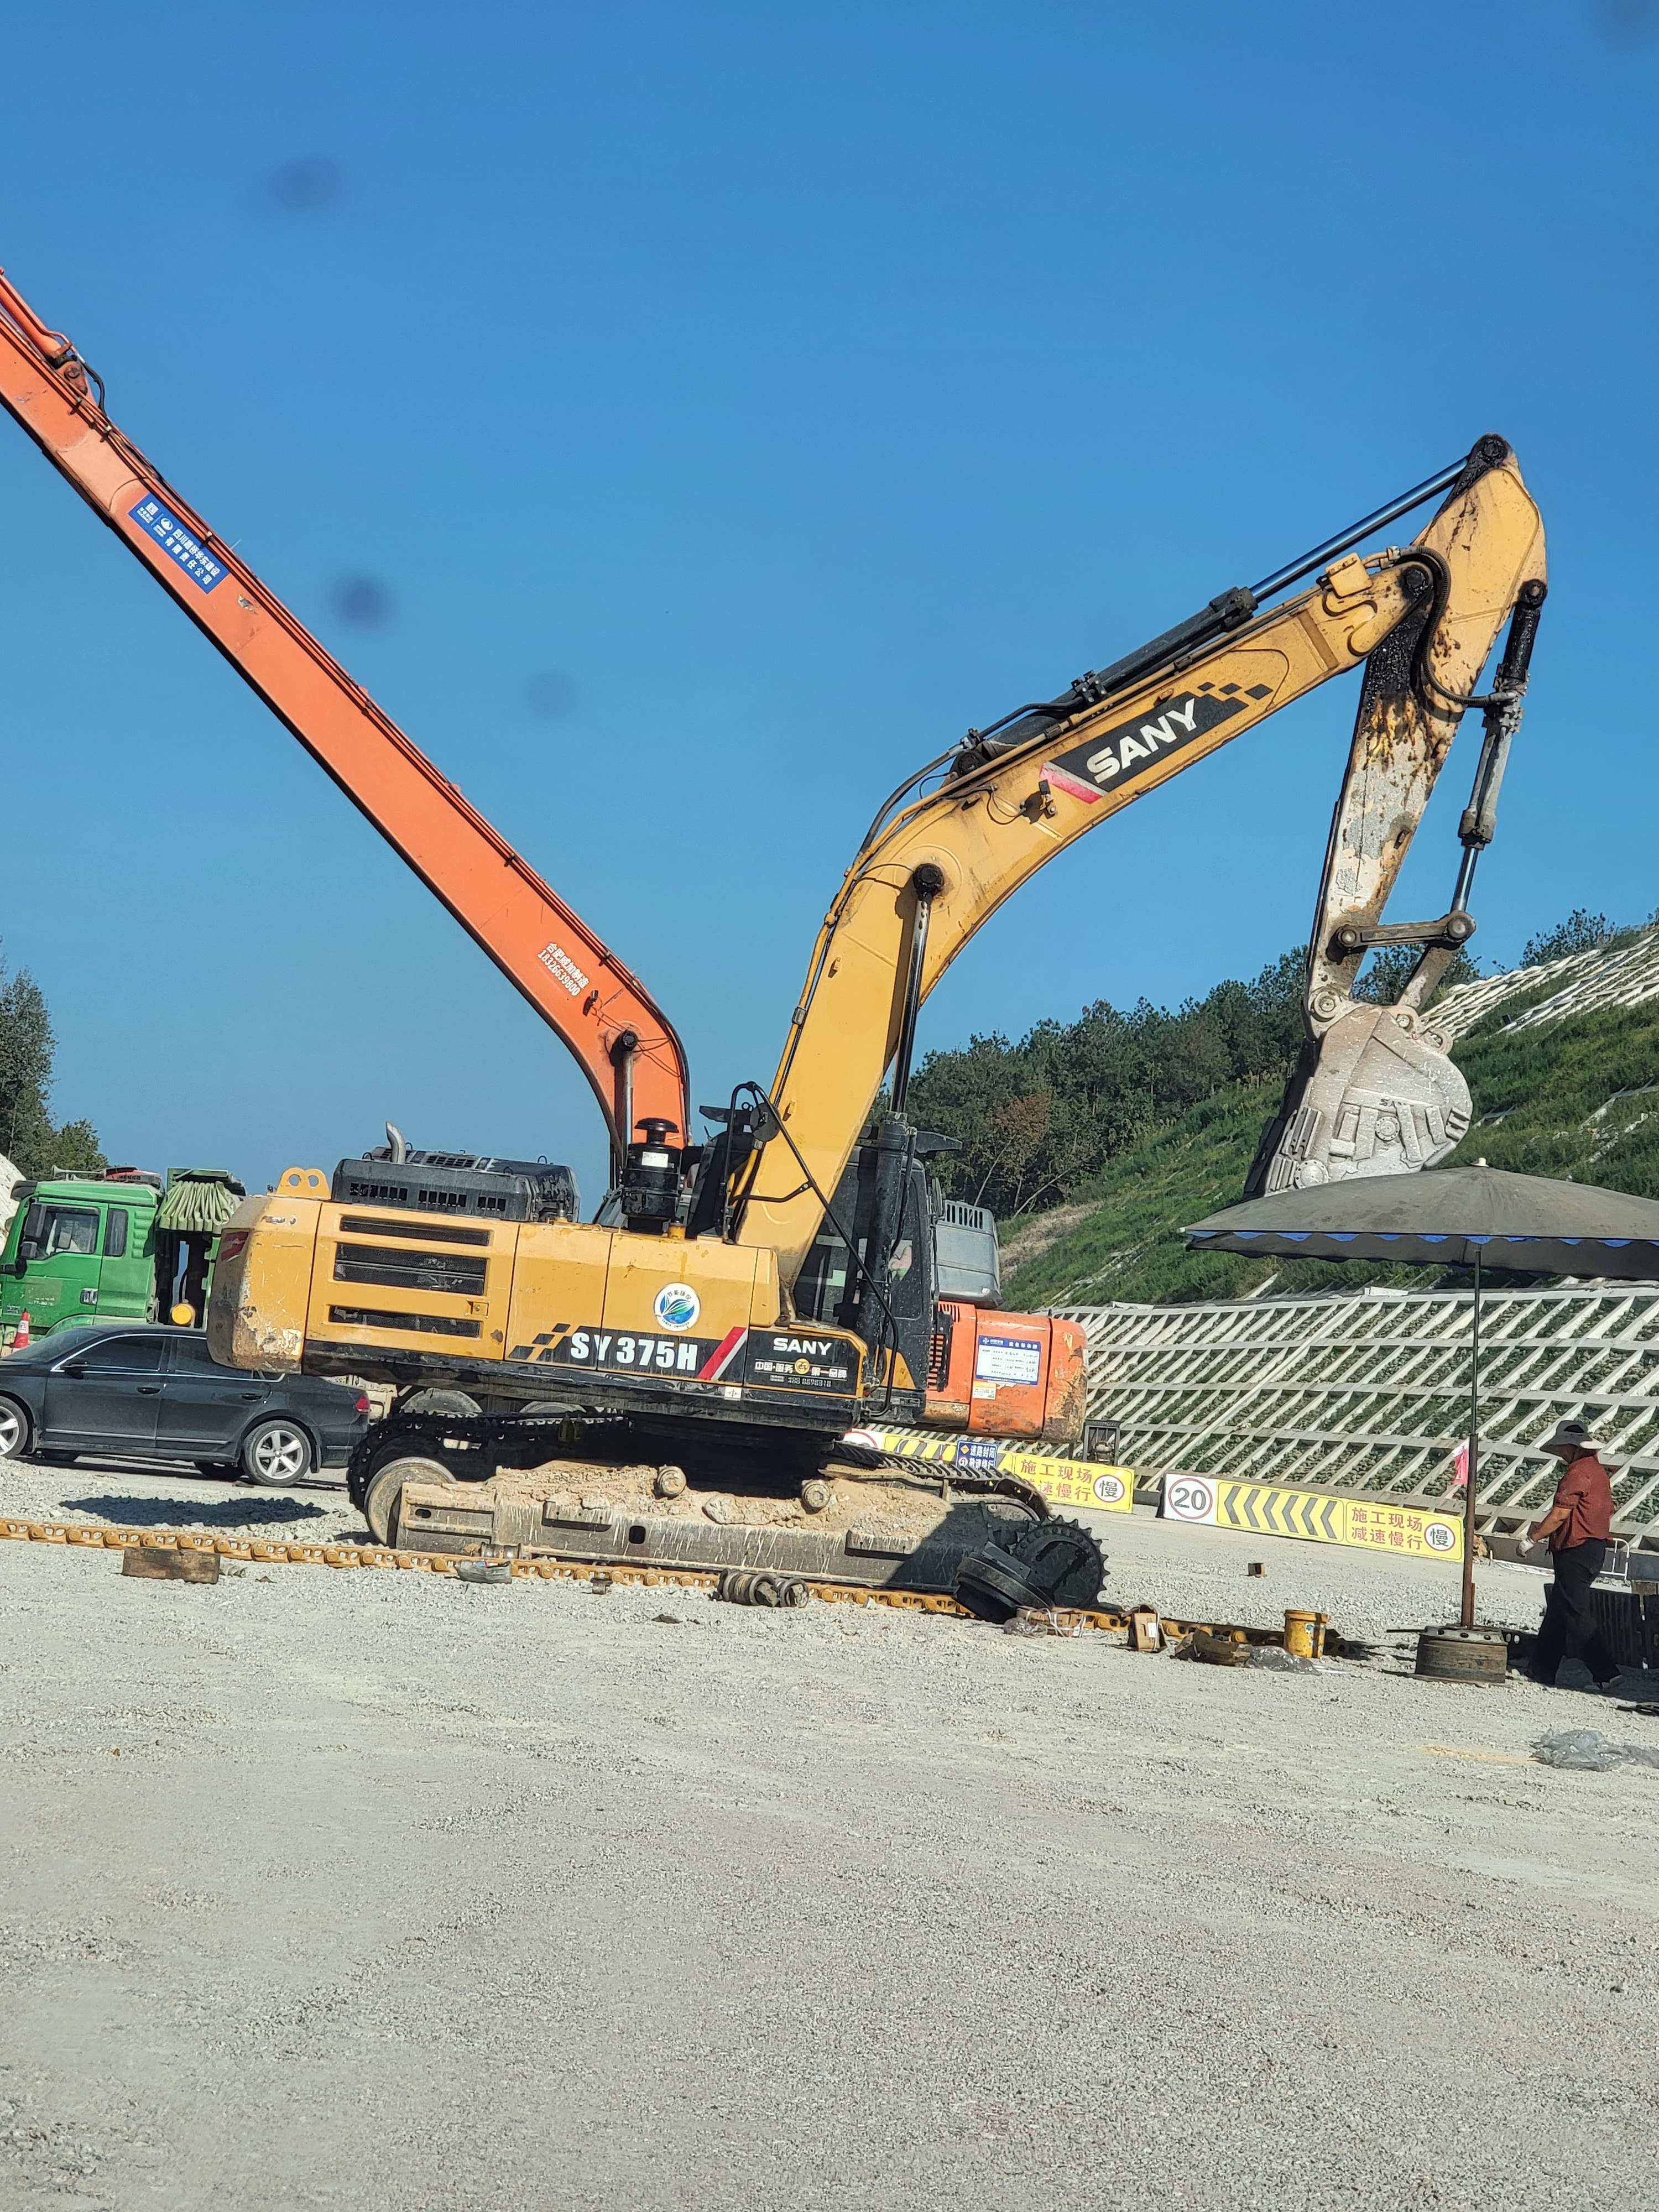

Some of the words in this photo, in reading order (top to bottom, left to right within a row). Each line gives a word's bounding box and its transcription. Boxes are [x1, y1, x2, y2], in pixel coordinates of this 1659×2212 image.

[165, 536, 212, 585] 有限责任公司
[1087, 698, 1197, 784] SANY
[538, 950, 581, 996] 18326639800
[571, 1332, 698, 1371] SY375H
[773, 1337, 832, 1355] SANY
[1020, 1459, 1093, 1484] 施工现场
[1028, 1478, 1092, 1501] 速慢行
[1099, 1480, 1118, 1499] 慢
[1173, 1487, 1207, 1511] 20
[1352, 1507, 1423, 1532] 施工现场
[1351, 1526, 1423, 1551] 减速慢行
[1429, 1528, 1449, 1548] 慢
